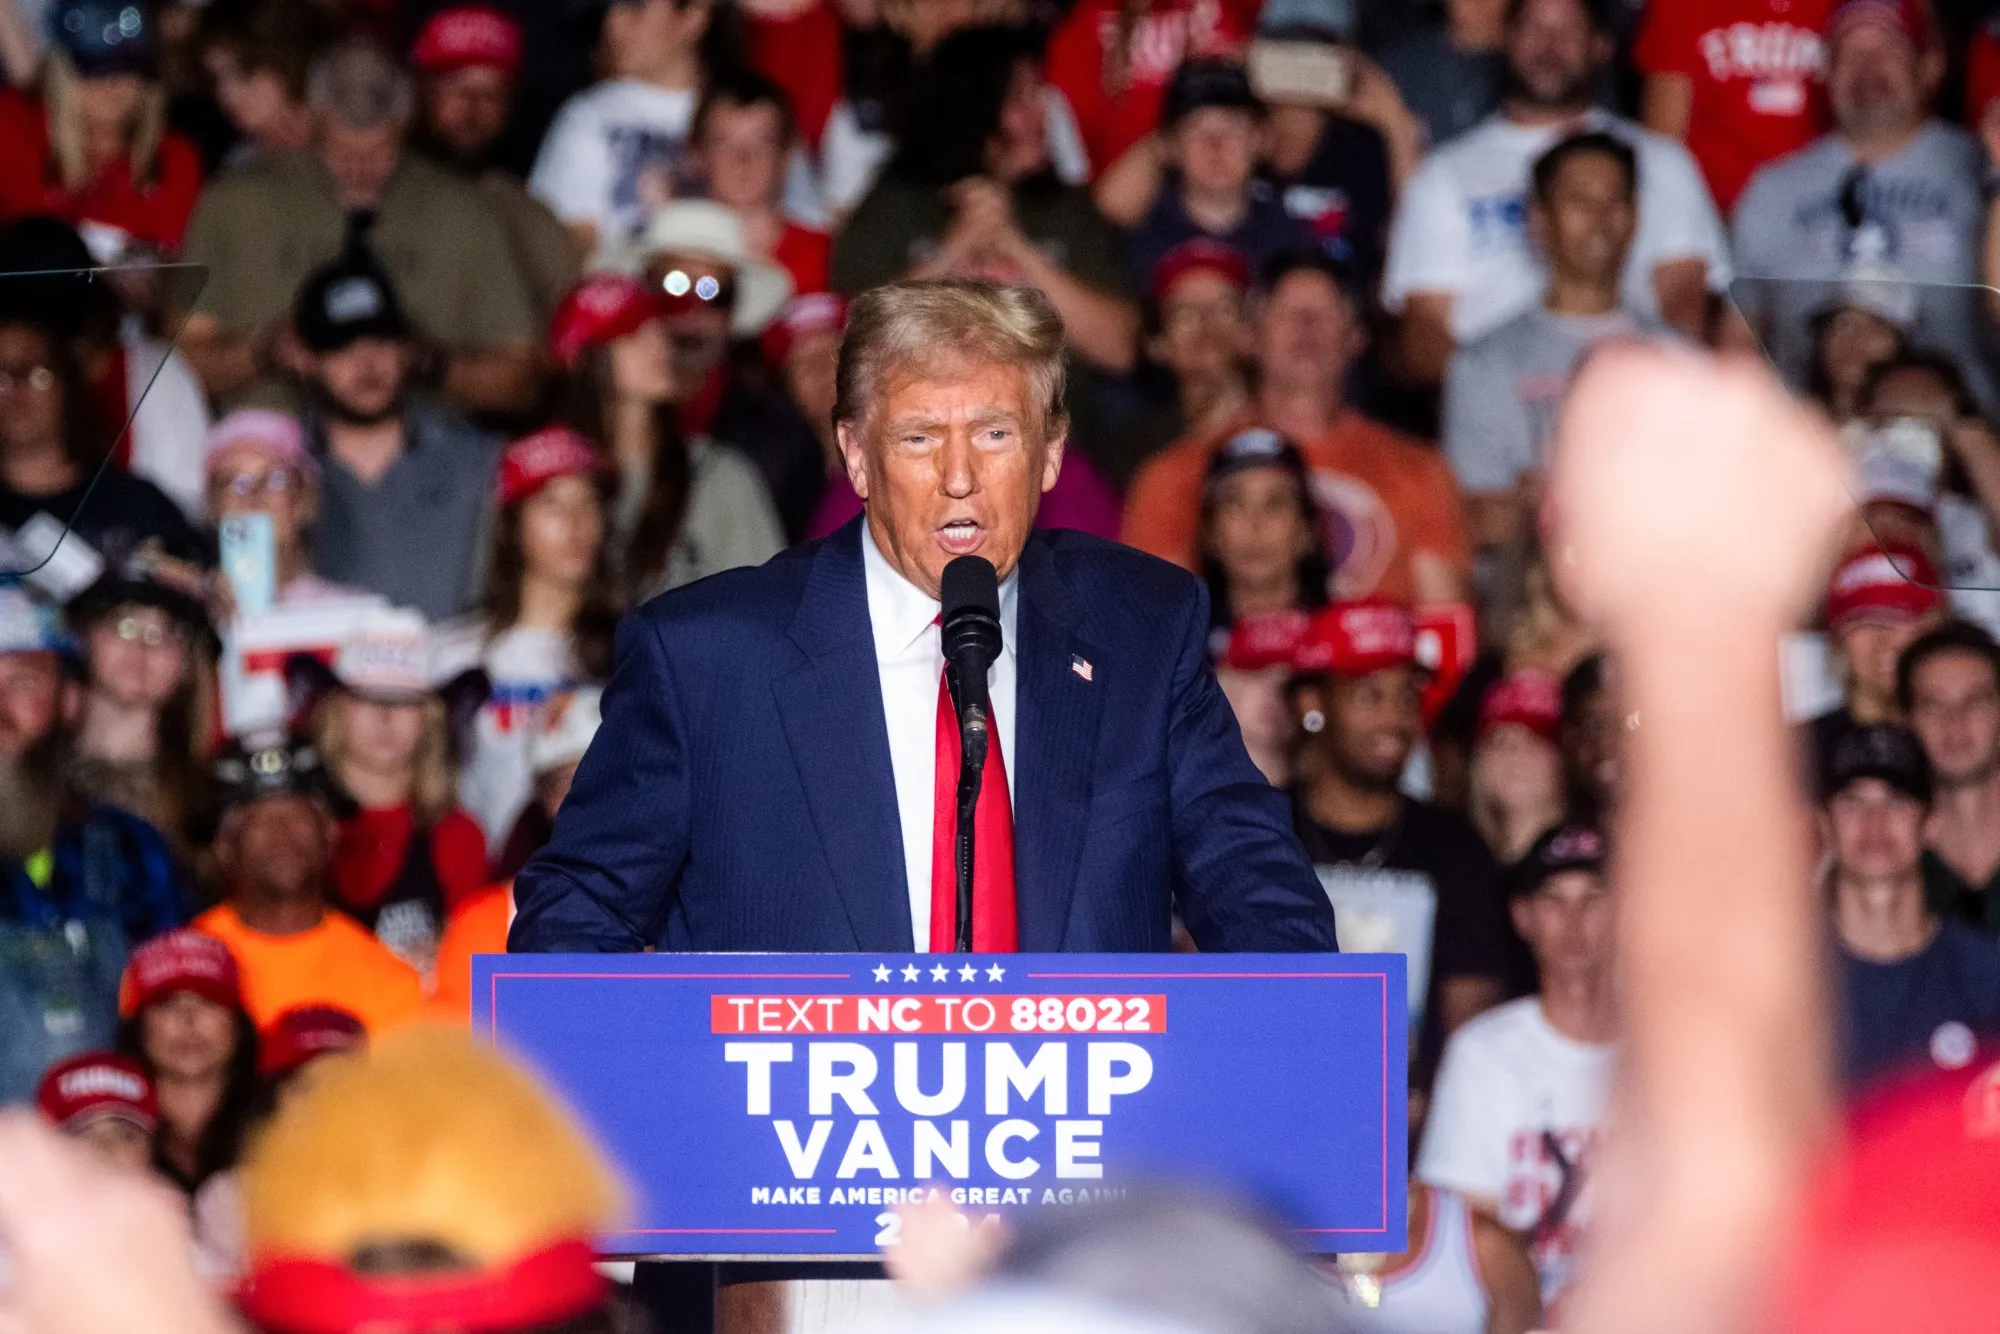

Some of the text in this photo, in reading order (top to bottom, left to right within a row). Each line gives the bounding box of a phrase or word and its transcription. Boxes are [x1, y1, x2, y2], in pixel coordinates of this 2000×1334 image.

[727, 998, 1151, 1032] TEXT NC TO 88022
[724, 1041, 1154, 1117] TRUMP
[772, 1119, 1104, 1180] VANCE
[751, 1187, 821, 1205] MAKE
[828, 1187, 942, 1205] AMERICA
[950, 1187, 1033, 1205] GREAT
